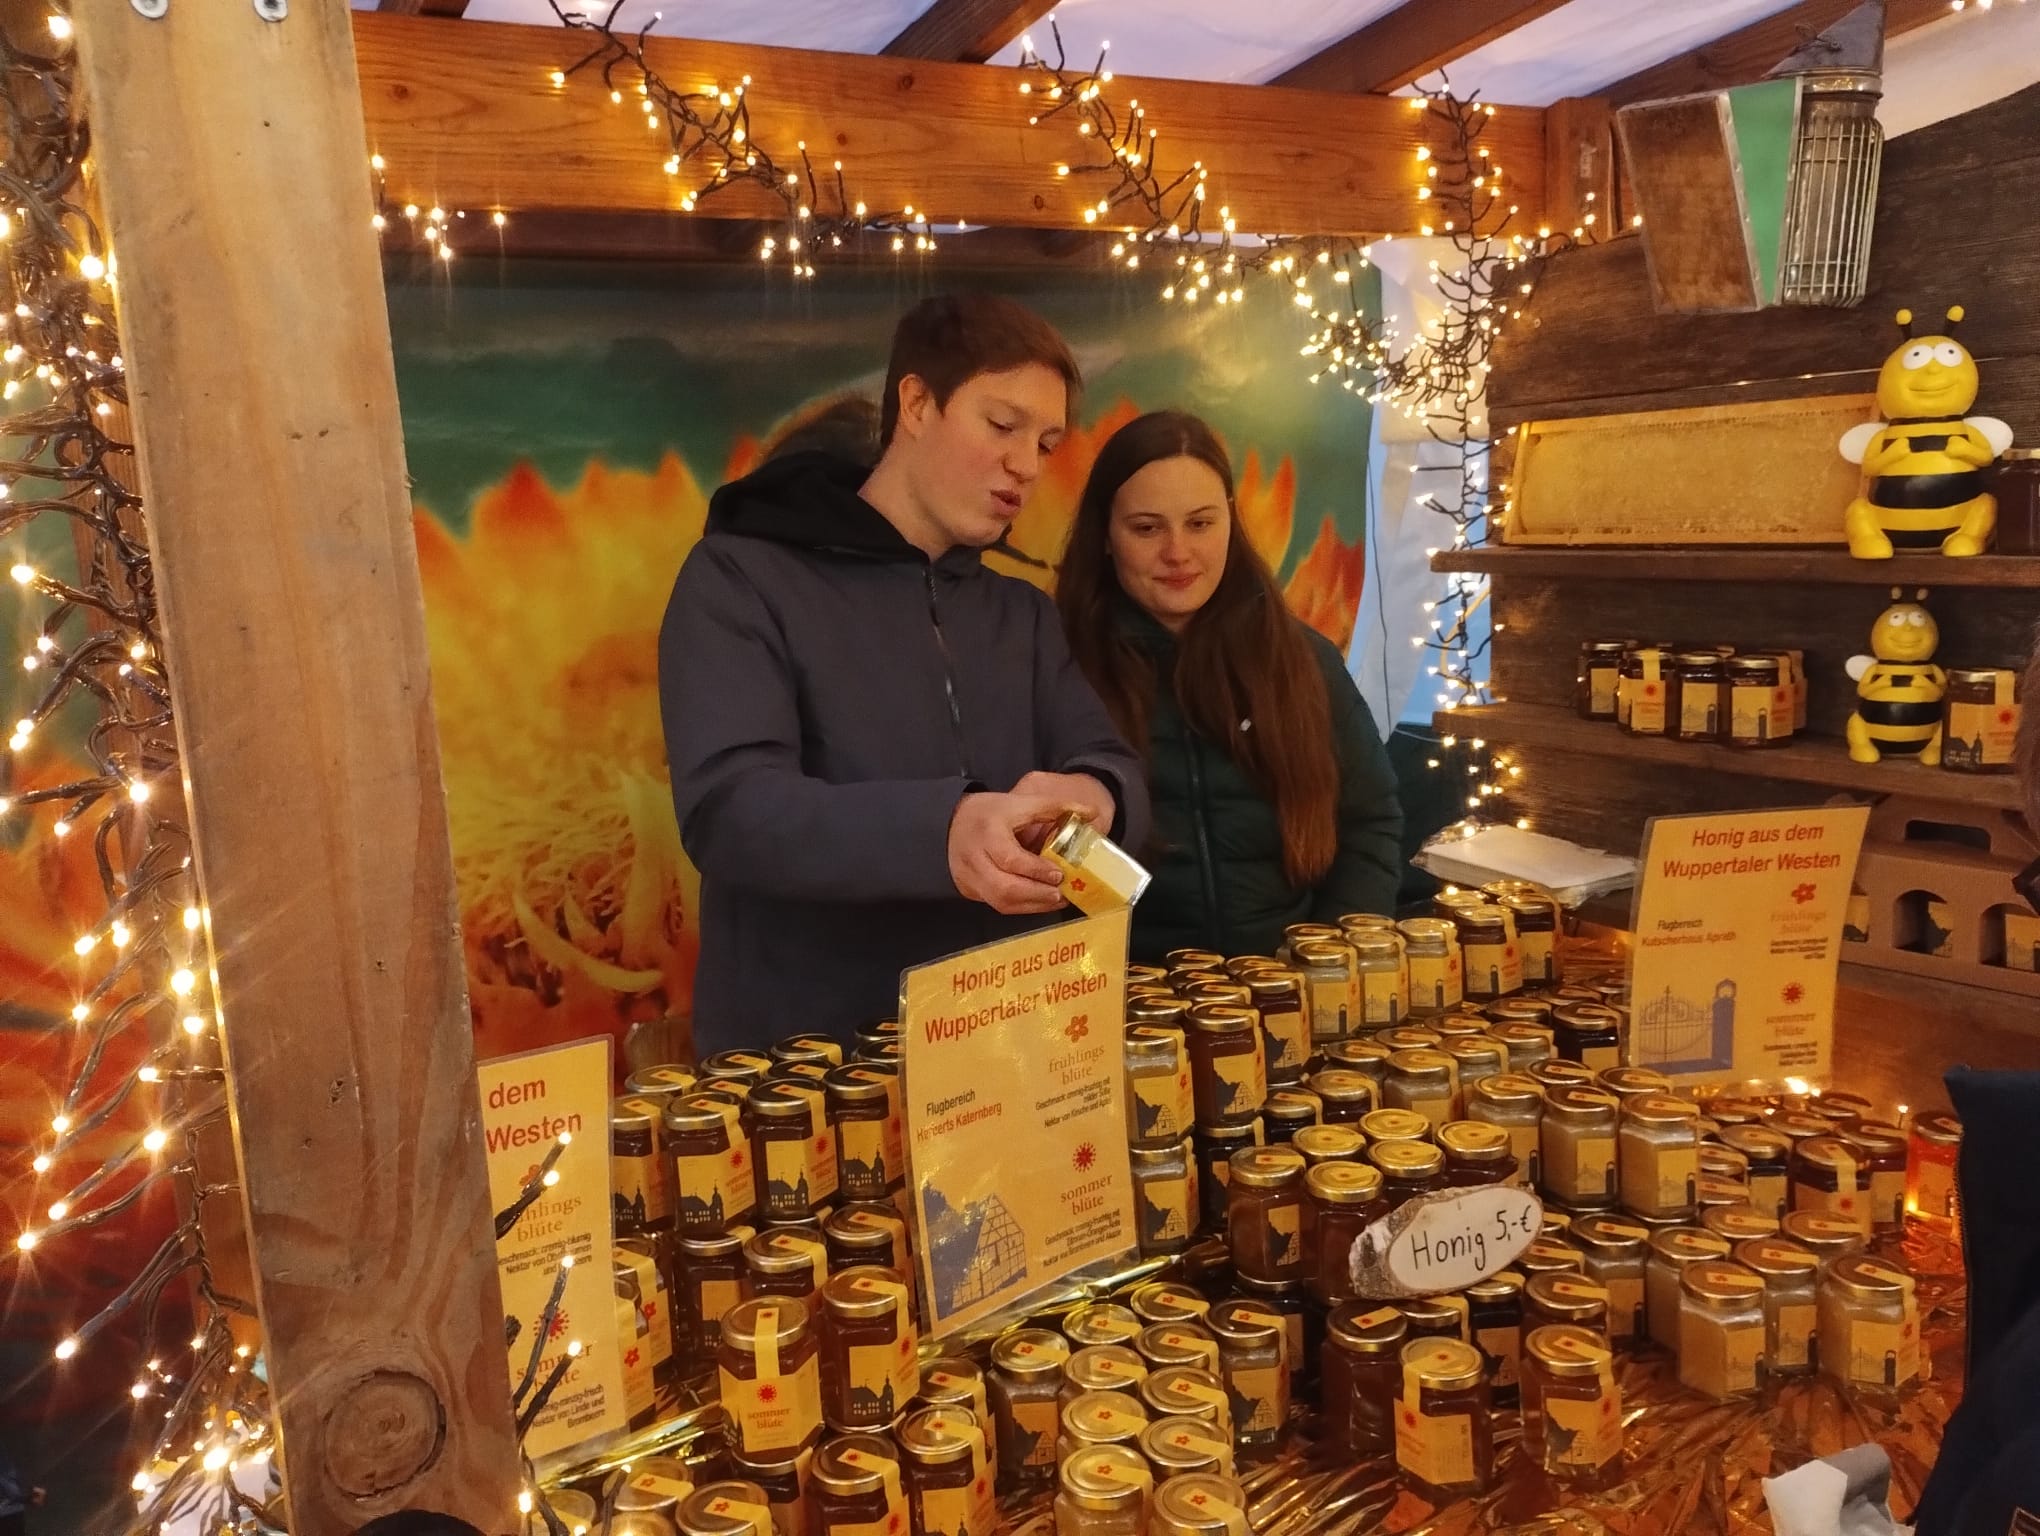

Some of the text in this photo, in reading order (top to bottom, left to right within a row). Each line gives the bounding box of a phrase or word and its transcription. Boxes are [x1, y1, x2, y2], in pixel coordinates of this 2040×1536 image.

[1692, 824, 1824, 849] Honig aus dem
[1663, 852, 1840, 880] Wuppertaler Westen
[952, 941, 1086, 997] Honig aus dem
[925, 971, 1108, 1044] Wuppertaler Westen
[488, 1079, 546, 1110] dem
[926, 1088, 977, 1116] Flugbereich
[955, 1102, 1002, 1129] Katernberg
[486, 1113, 582, 1154] Westen
[1060, 1174, 1113, 1204] sommer
[519, 1196, 582, 1223] hlings
[1071, 1195, 1104, 1216] blüte
[516, 1219, 563, 1242] blüte
[1410, 1226, 1487, 1271] Honig
